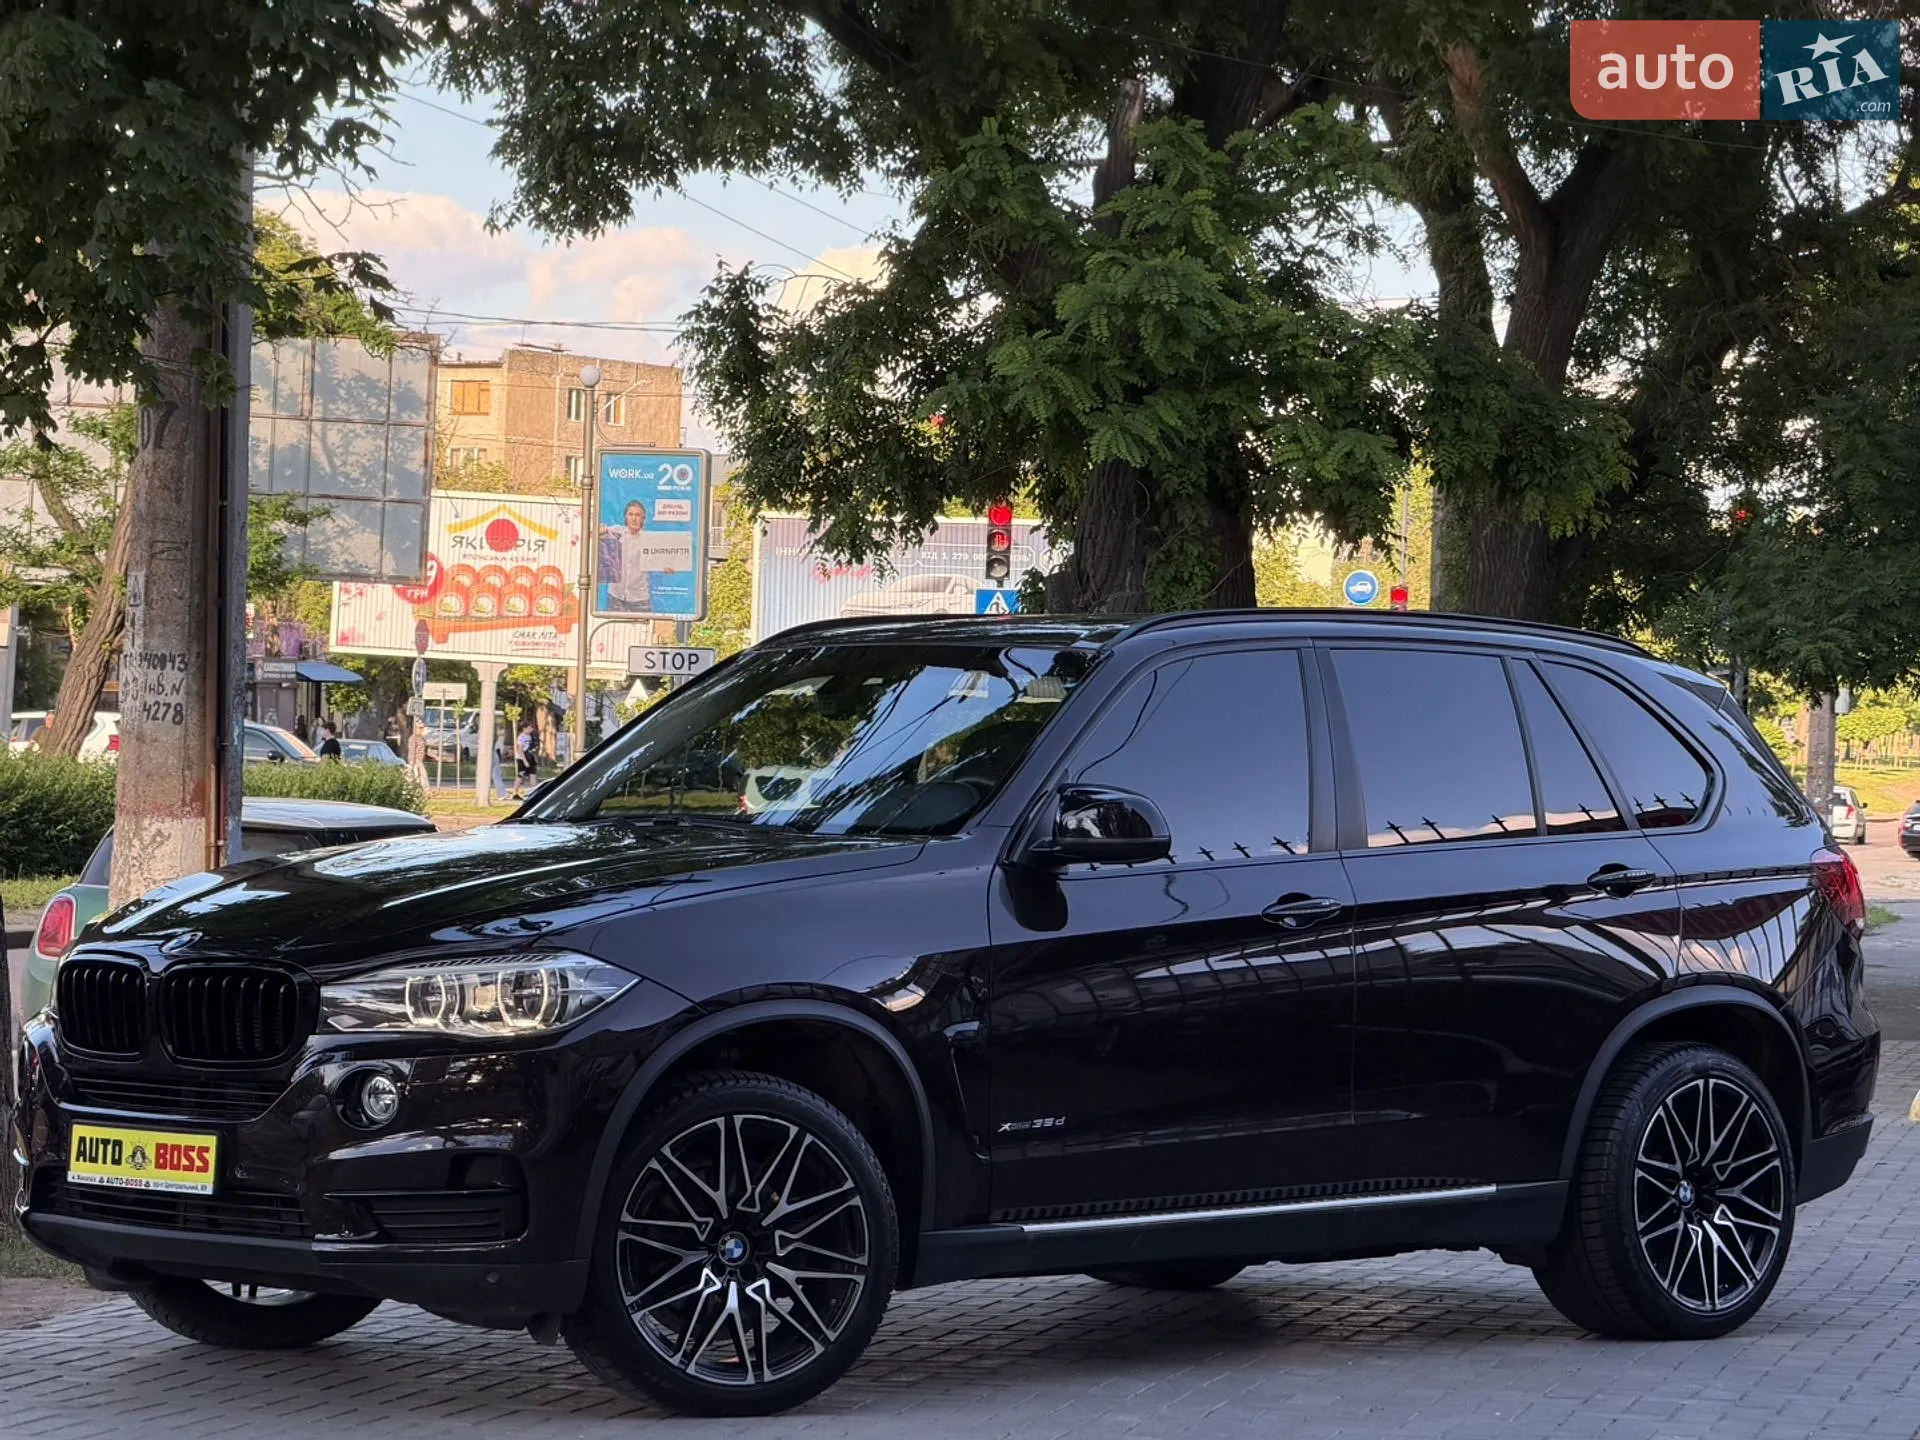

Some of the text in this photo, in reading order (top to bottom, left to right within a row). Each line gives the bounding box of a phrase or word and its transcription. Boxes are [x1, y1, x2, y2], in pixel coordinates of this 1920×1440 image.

[608, 468, 655, 479] WORK.ua
[657, 463, 694, 486] 20
[644, 651, 699, 671] STOP
[142, 700, 184, 725] 4278
[75, 1136, 211, 1174] AUTO BOSS
